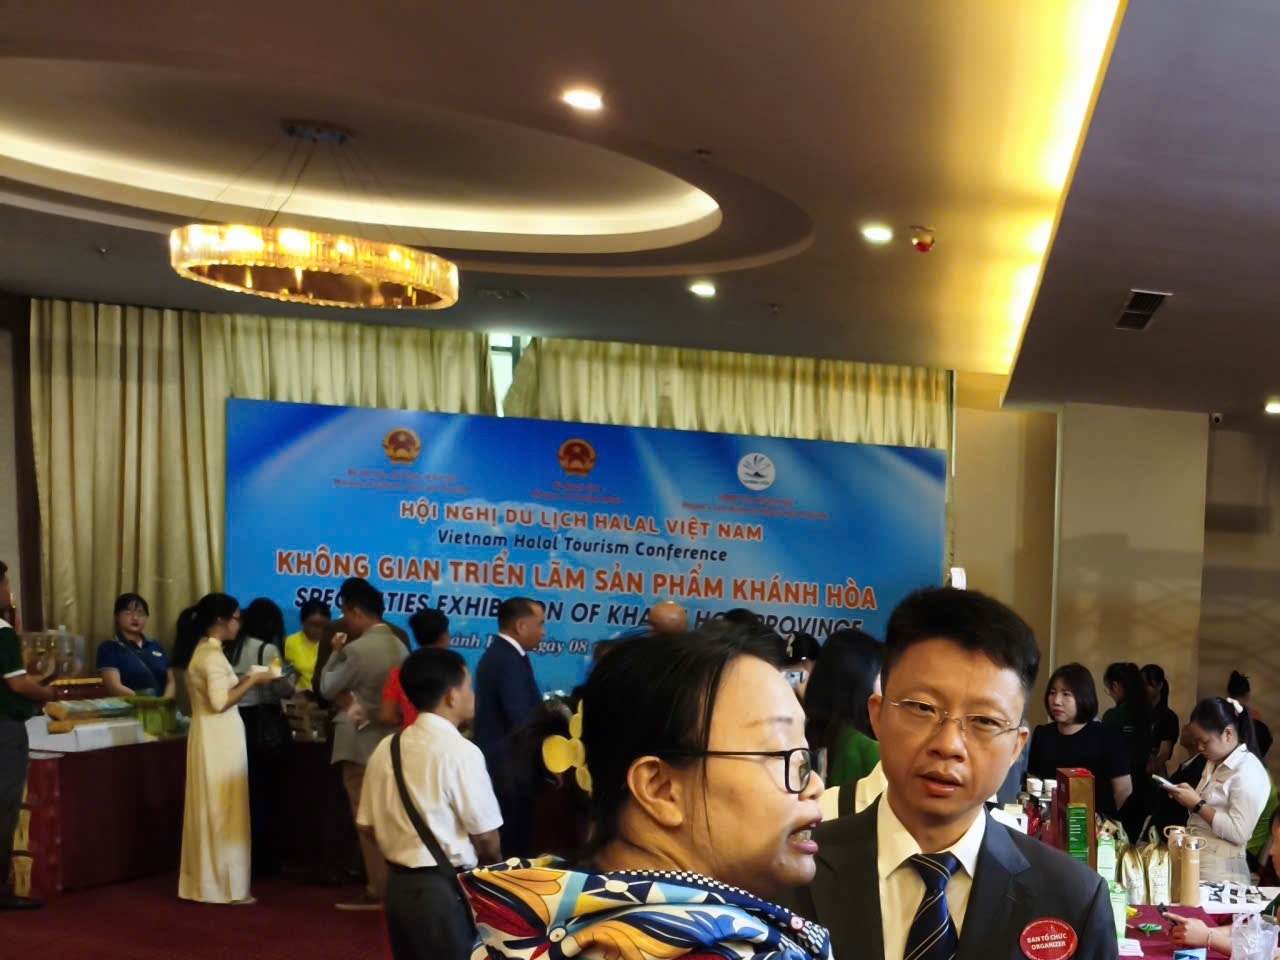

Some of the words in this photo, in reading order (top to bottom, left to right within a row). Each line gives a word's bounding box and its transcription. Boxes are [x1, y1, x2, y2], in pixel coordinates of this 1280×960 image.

[401, 497, 437, 522] HỘI
[446, 505, 497, 525] NGHỊ
[505, 508, 532, 525] DU
[541, 511, 586, 529] LỊCH
[595, 513, 659, 534] HALAL
[667, 517, 710, 540] VIỆT
[718, 523, 762, 540] NAM
[438, 529, 508, 547] Vietnam
[514, 533, 558, 550] Halal
[564, 537, 629, 555] Tourism
[635, 541, 728, 561] Conference
[277, 546, 370, 577] KHÔNG
[378, 557, 440, 582] GIAN
[449, 550, 524, 586] TRIỂN
[534, 561, 585, 589] LÃM
[595, 563, 643, 594] SẢN
[653, 564, 723, 599] PHẨM
[733, 575, 818, 606] KHÁNH
[827, 579, 877, 610] HÒA
[571, 603, 600, 622] OF
[569, 640, 588, 653] 08
[1031, 941, 1066, 950] ORGANIZER
